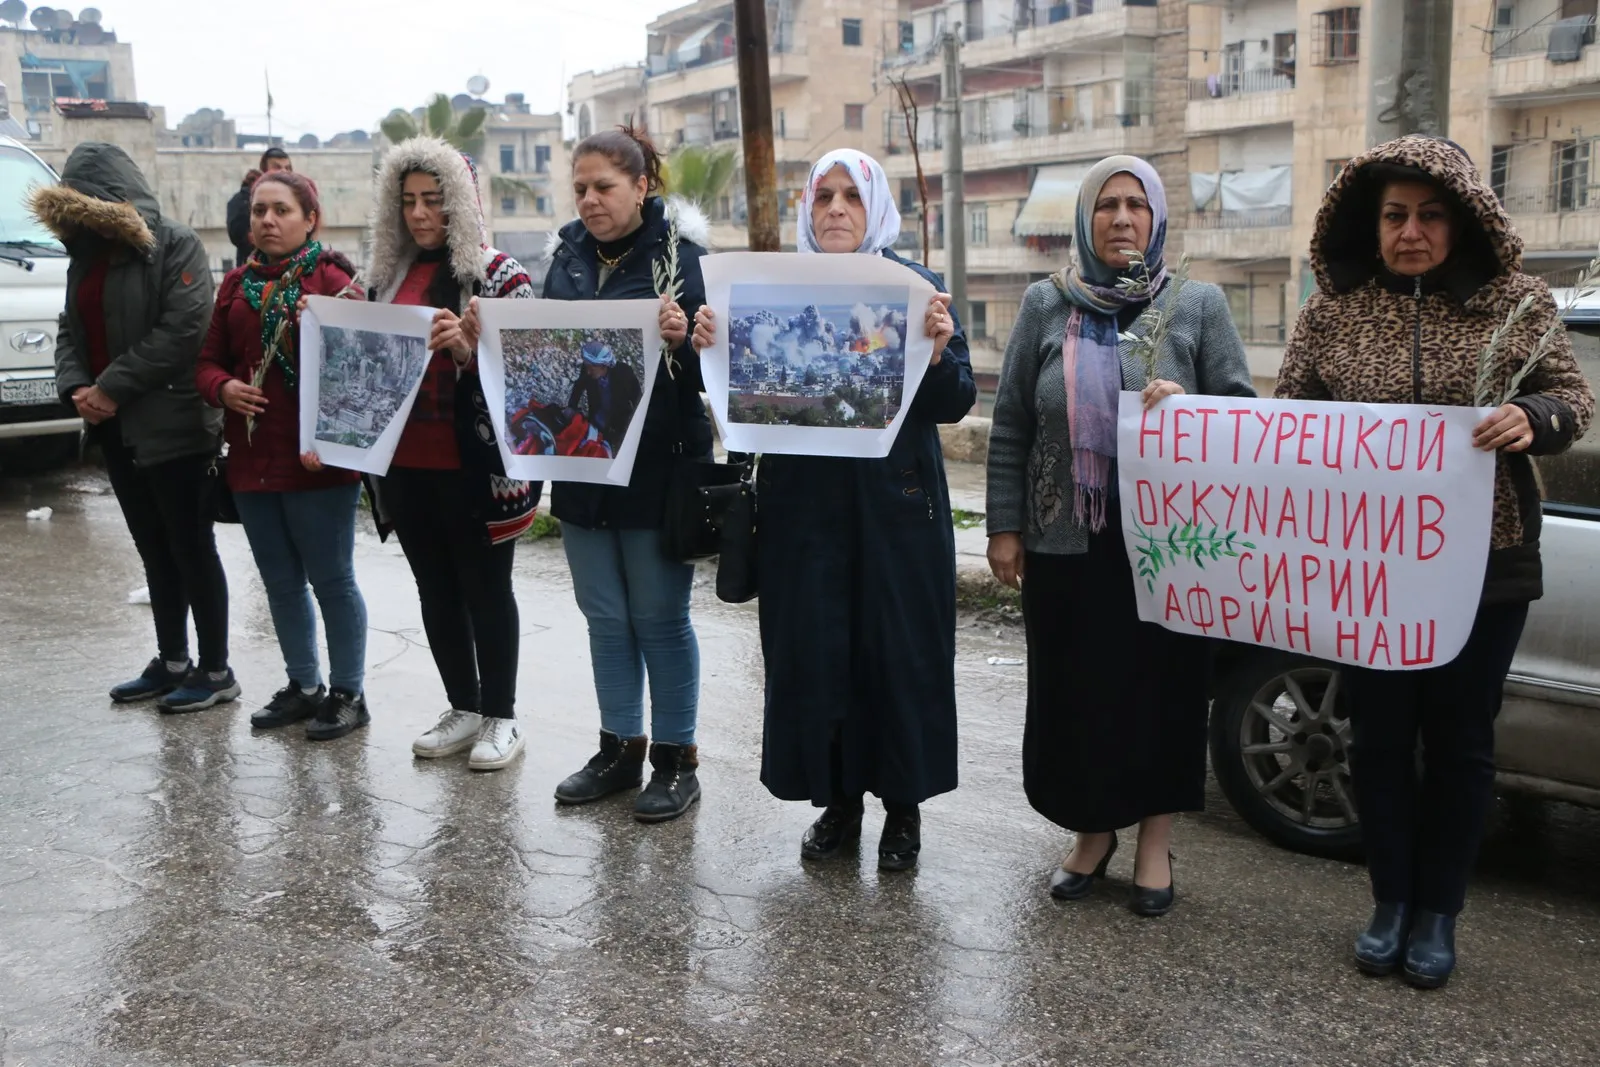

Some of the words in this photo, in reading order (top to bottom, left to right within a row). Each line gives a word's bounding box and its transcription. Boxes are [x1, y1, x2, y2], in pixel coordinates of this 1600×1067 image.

[1238, 552, 1388, 617] СИРИИ
[1165, 581, 1311, 653] АФРИН
[1336, 620, 1435, 666] НАШ
